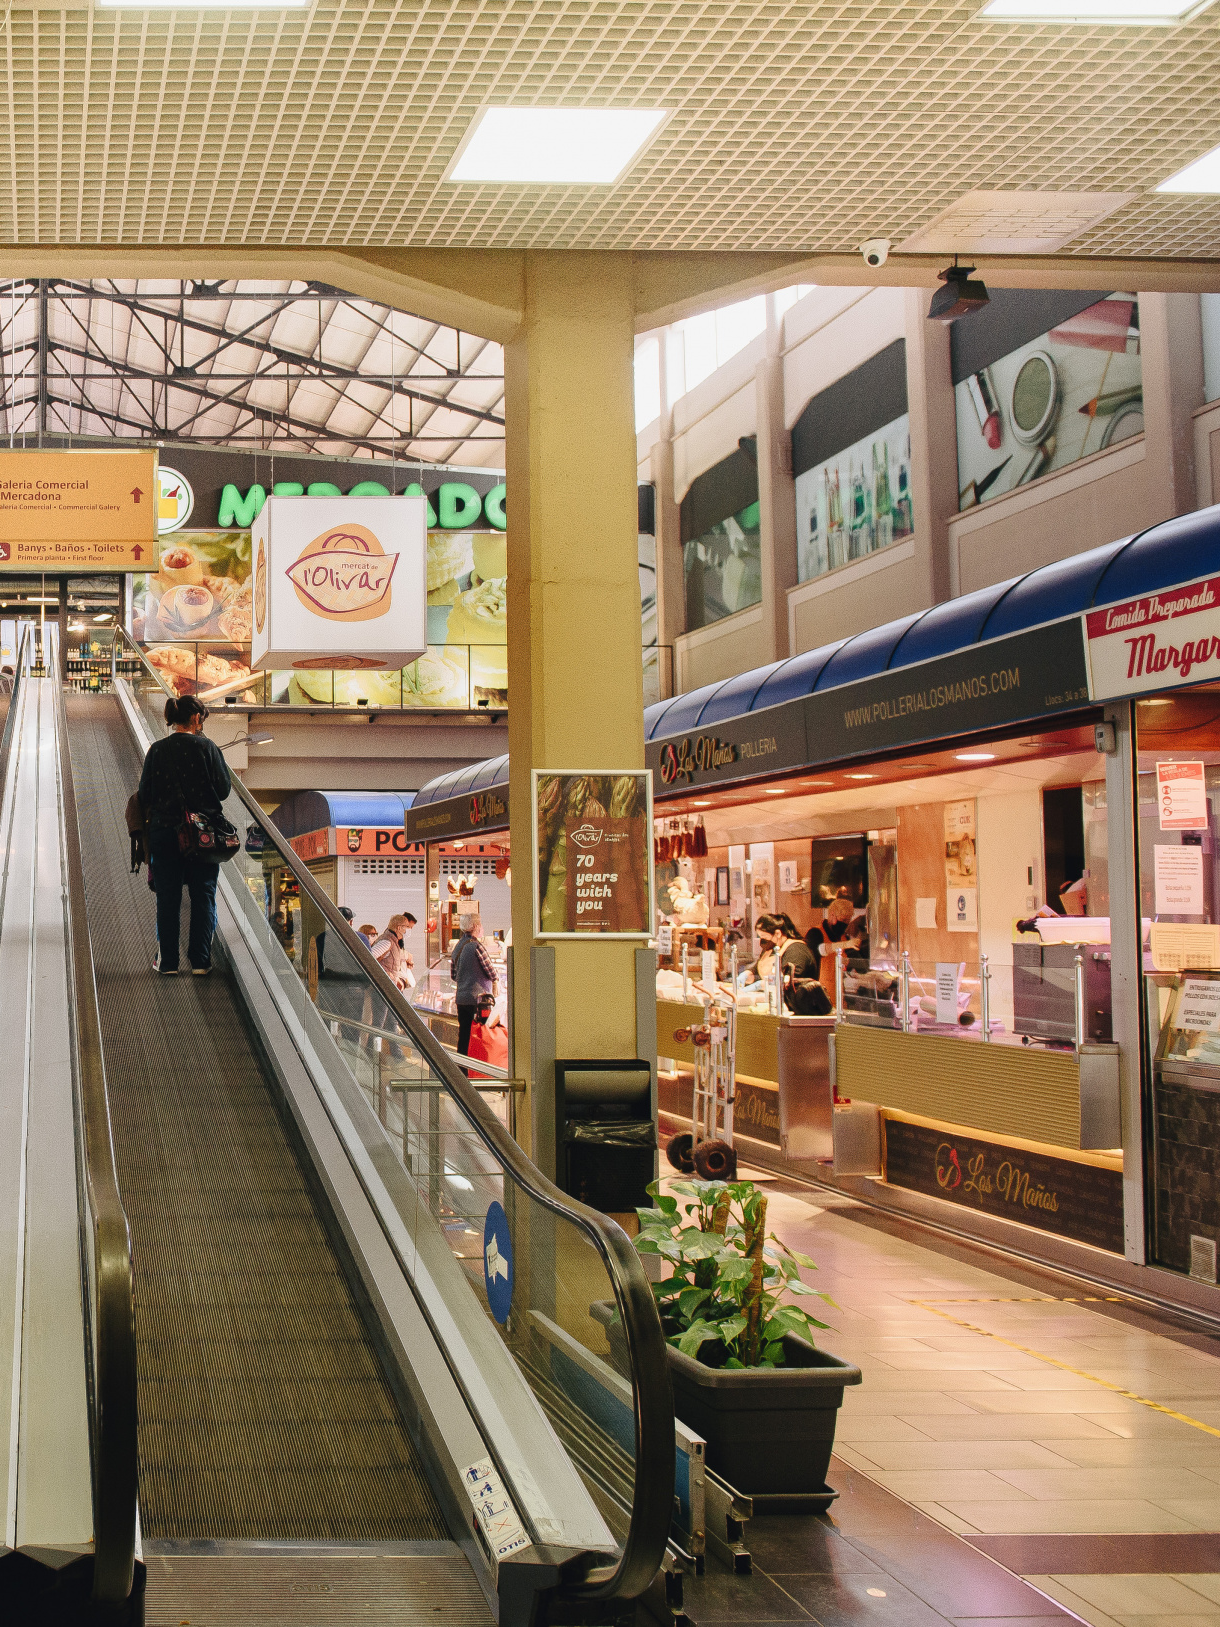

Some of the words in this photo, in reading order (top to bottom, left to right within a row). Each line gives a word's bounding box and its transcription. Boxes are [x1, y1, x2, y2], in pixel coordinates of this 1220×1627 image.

[36, 480, 89, 489] Comercial
[1, 492, 61, 501] Mercadona
[17, 543, 47, 553] Banys
[55, 542, 85, 552] Baños
[93, 543, 125, 552] Toilets
[341, 562, 370, 570] mercat
[304, 566, 387, 591] l'Olivar
[1105, 602, 1147, 631] Comida
[1148, 583, 1217, 620] Preparada
[844, 667, 1021, 729] WWW.POLLERIALOSMANOS.COM
[741, 737, 778, 759] POLLERIA
[576, 855, 595, 867] 70
[576, 873, 619, 887] years
[576, 884, 612, 897] with
[576, 900, 603, 914] you
[498, 1539, 526, 1554] OTIS
